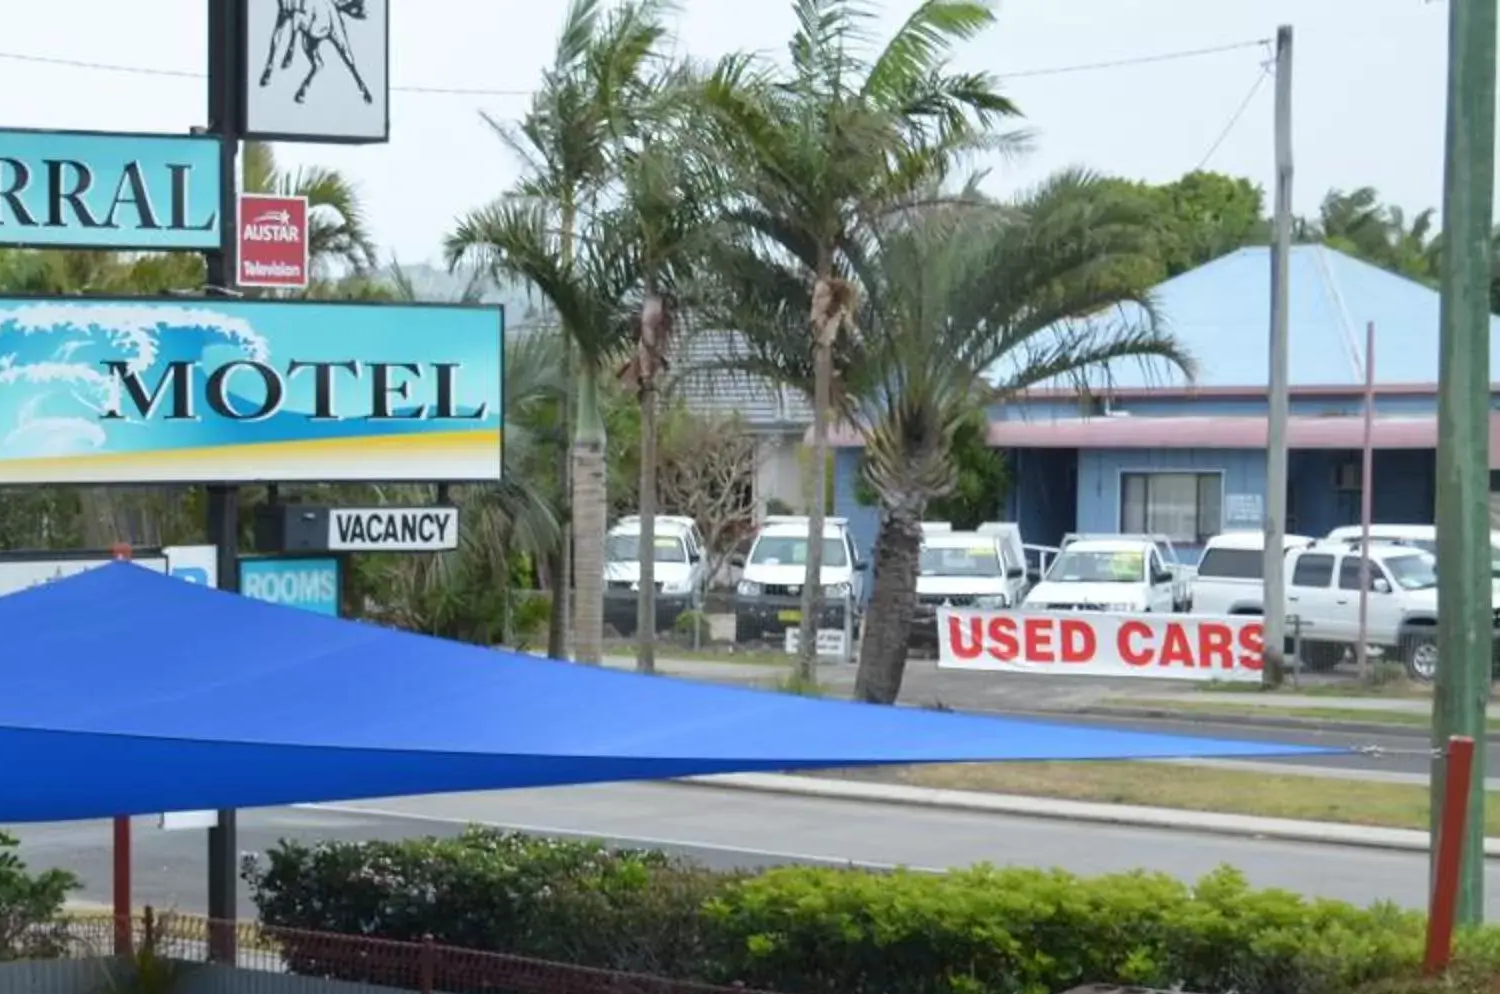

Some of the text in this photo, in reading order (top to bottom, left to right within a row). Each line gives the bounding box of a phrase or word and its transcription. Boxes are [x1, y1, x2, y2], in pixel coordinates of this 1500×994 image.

[243, 223, 300, 242] AUSTAR
[243, 260, 301, 278] Television
[100, 358, 488, 423] MOTEL
[336, 513, 451, 544] VACANCY
[244, 568, 335, 603] ROOMS
[948, 615, 1266, 672] USED CARS
